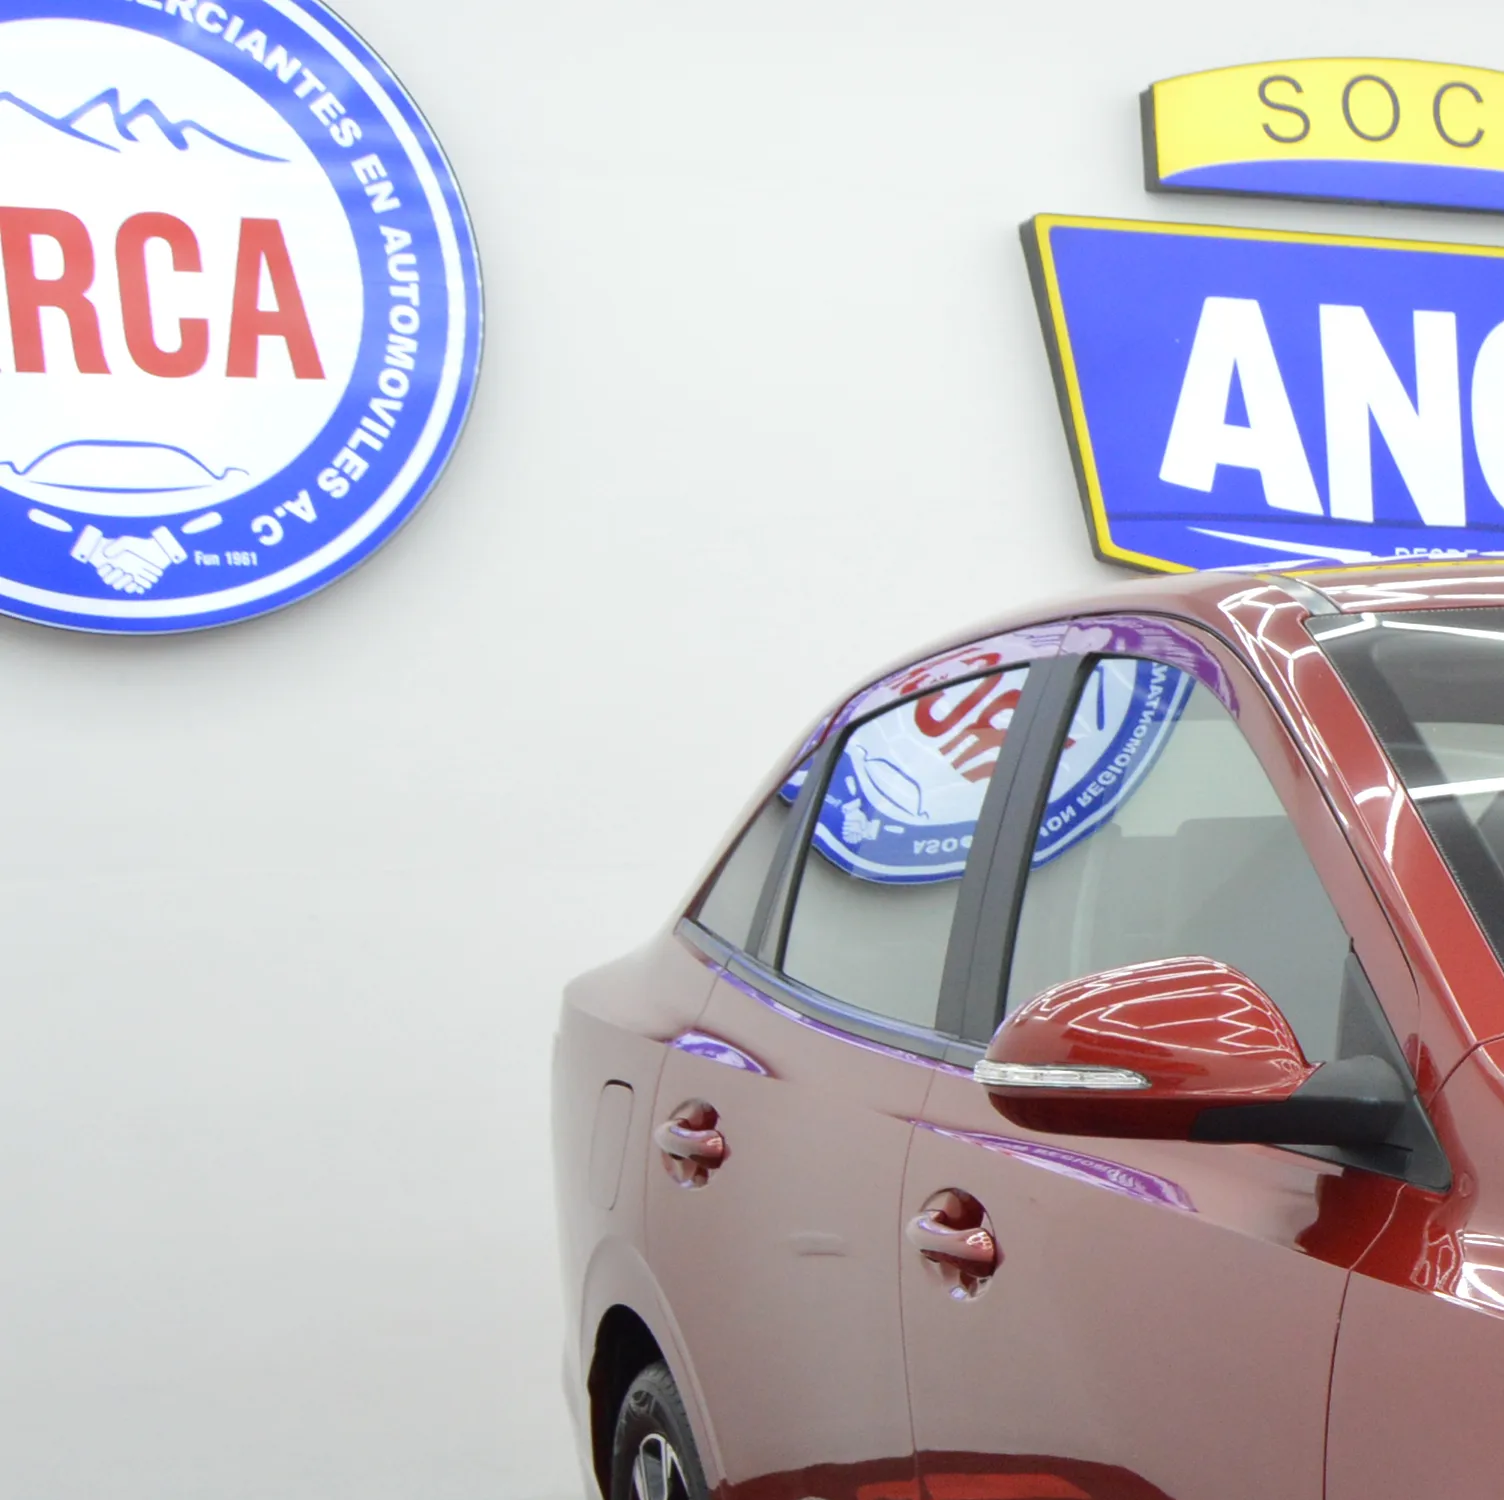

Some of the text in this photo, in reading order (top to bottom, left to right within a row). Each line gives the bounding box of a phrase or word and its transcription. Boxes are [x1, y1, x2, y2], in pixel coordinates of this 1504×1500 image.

[124, 0, 363, 148] RCIANTES
[351, 154, 401, 213] EN
[0, 206, 326, 379] RCA
[317, 225, 421, 499] AUTOMOVILES
